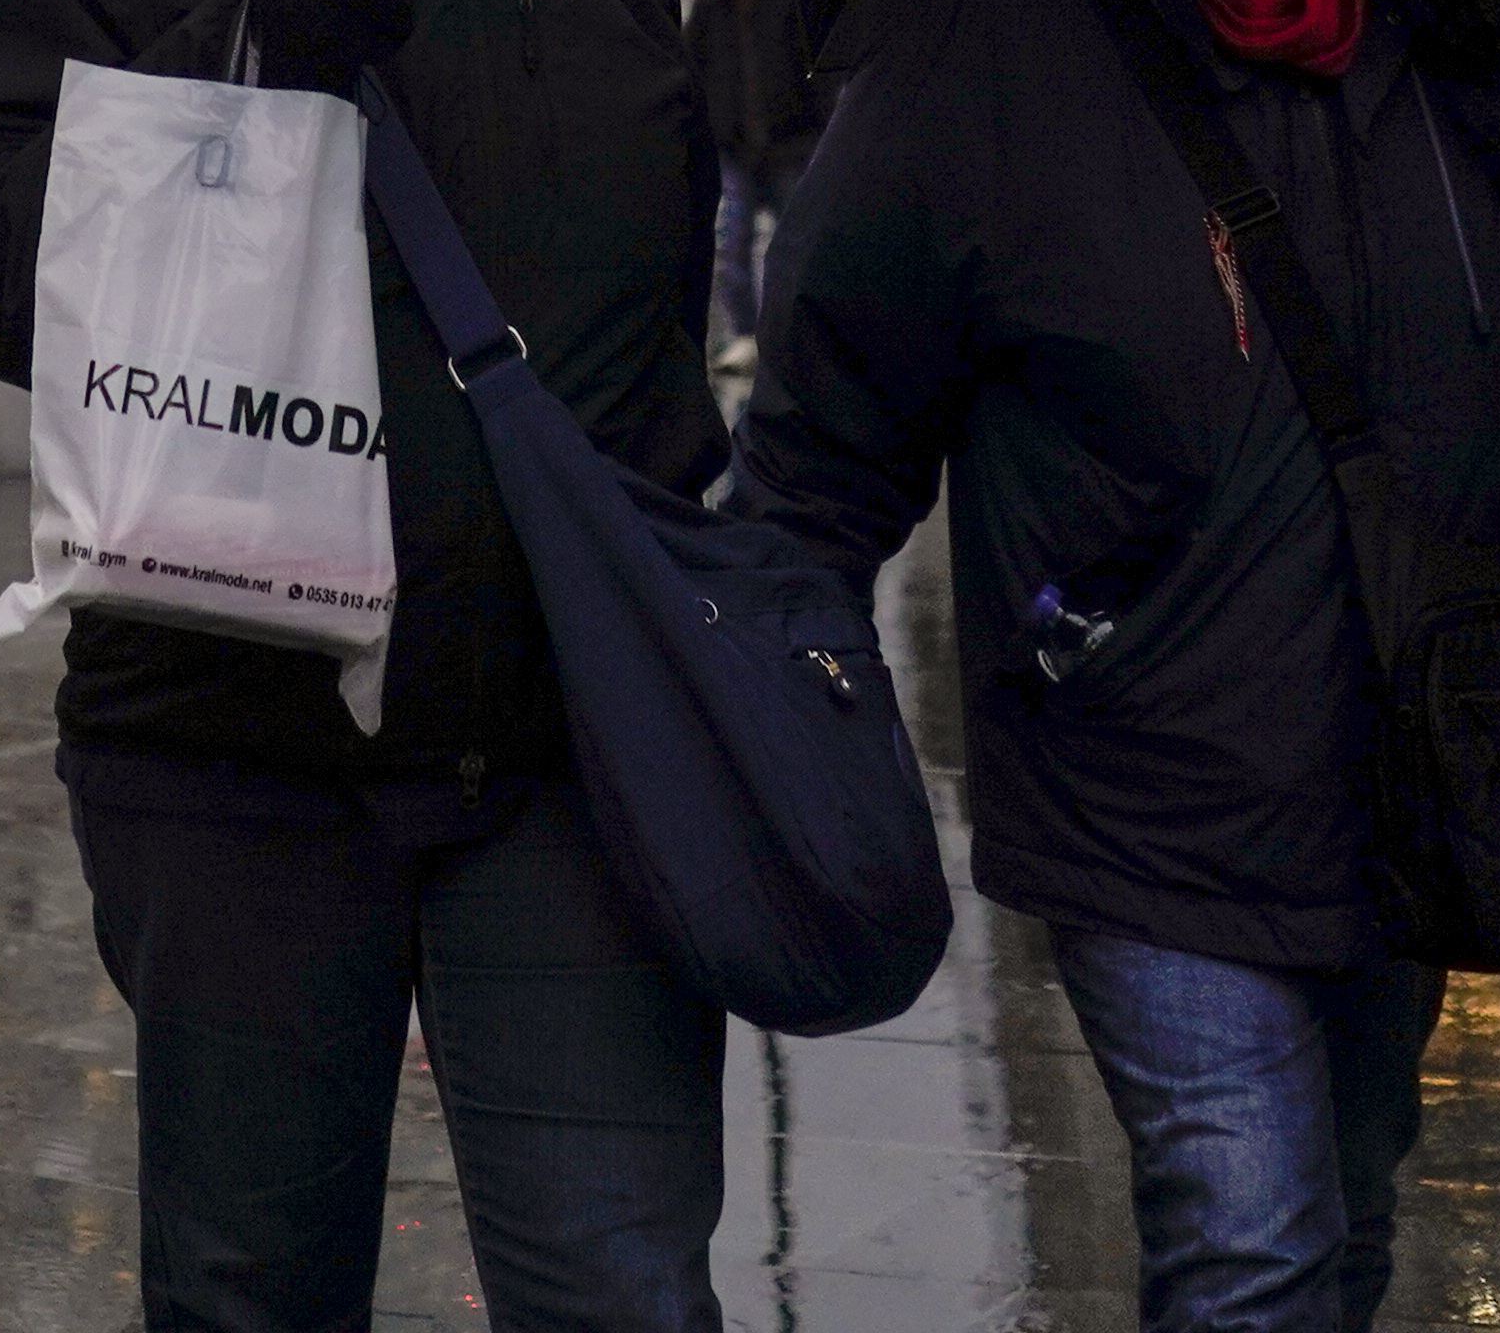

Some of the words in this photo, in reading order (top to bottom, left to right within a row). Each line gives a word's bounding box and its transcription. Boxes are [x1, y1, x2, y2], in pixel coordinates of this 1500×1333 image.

[159, 562, 273, 594] www.kralmoda.net
[306, 586, 338, 605] 0535
[340, 592, 364, 610] 013
